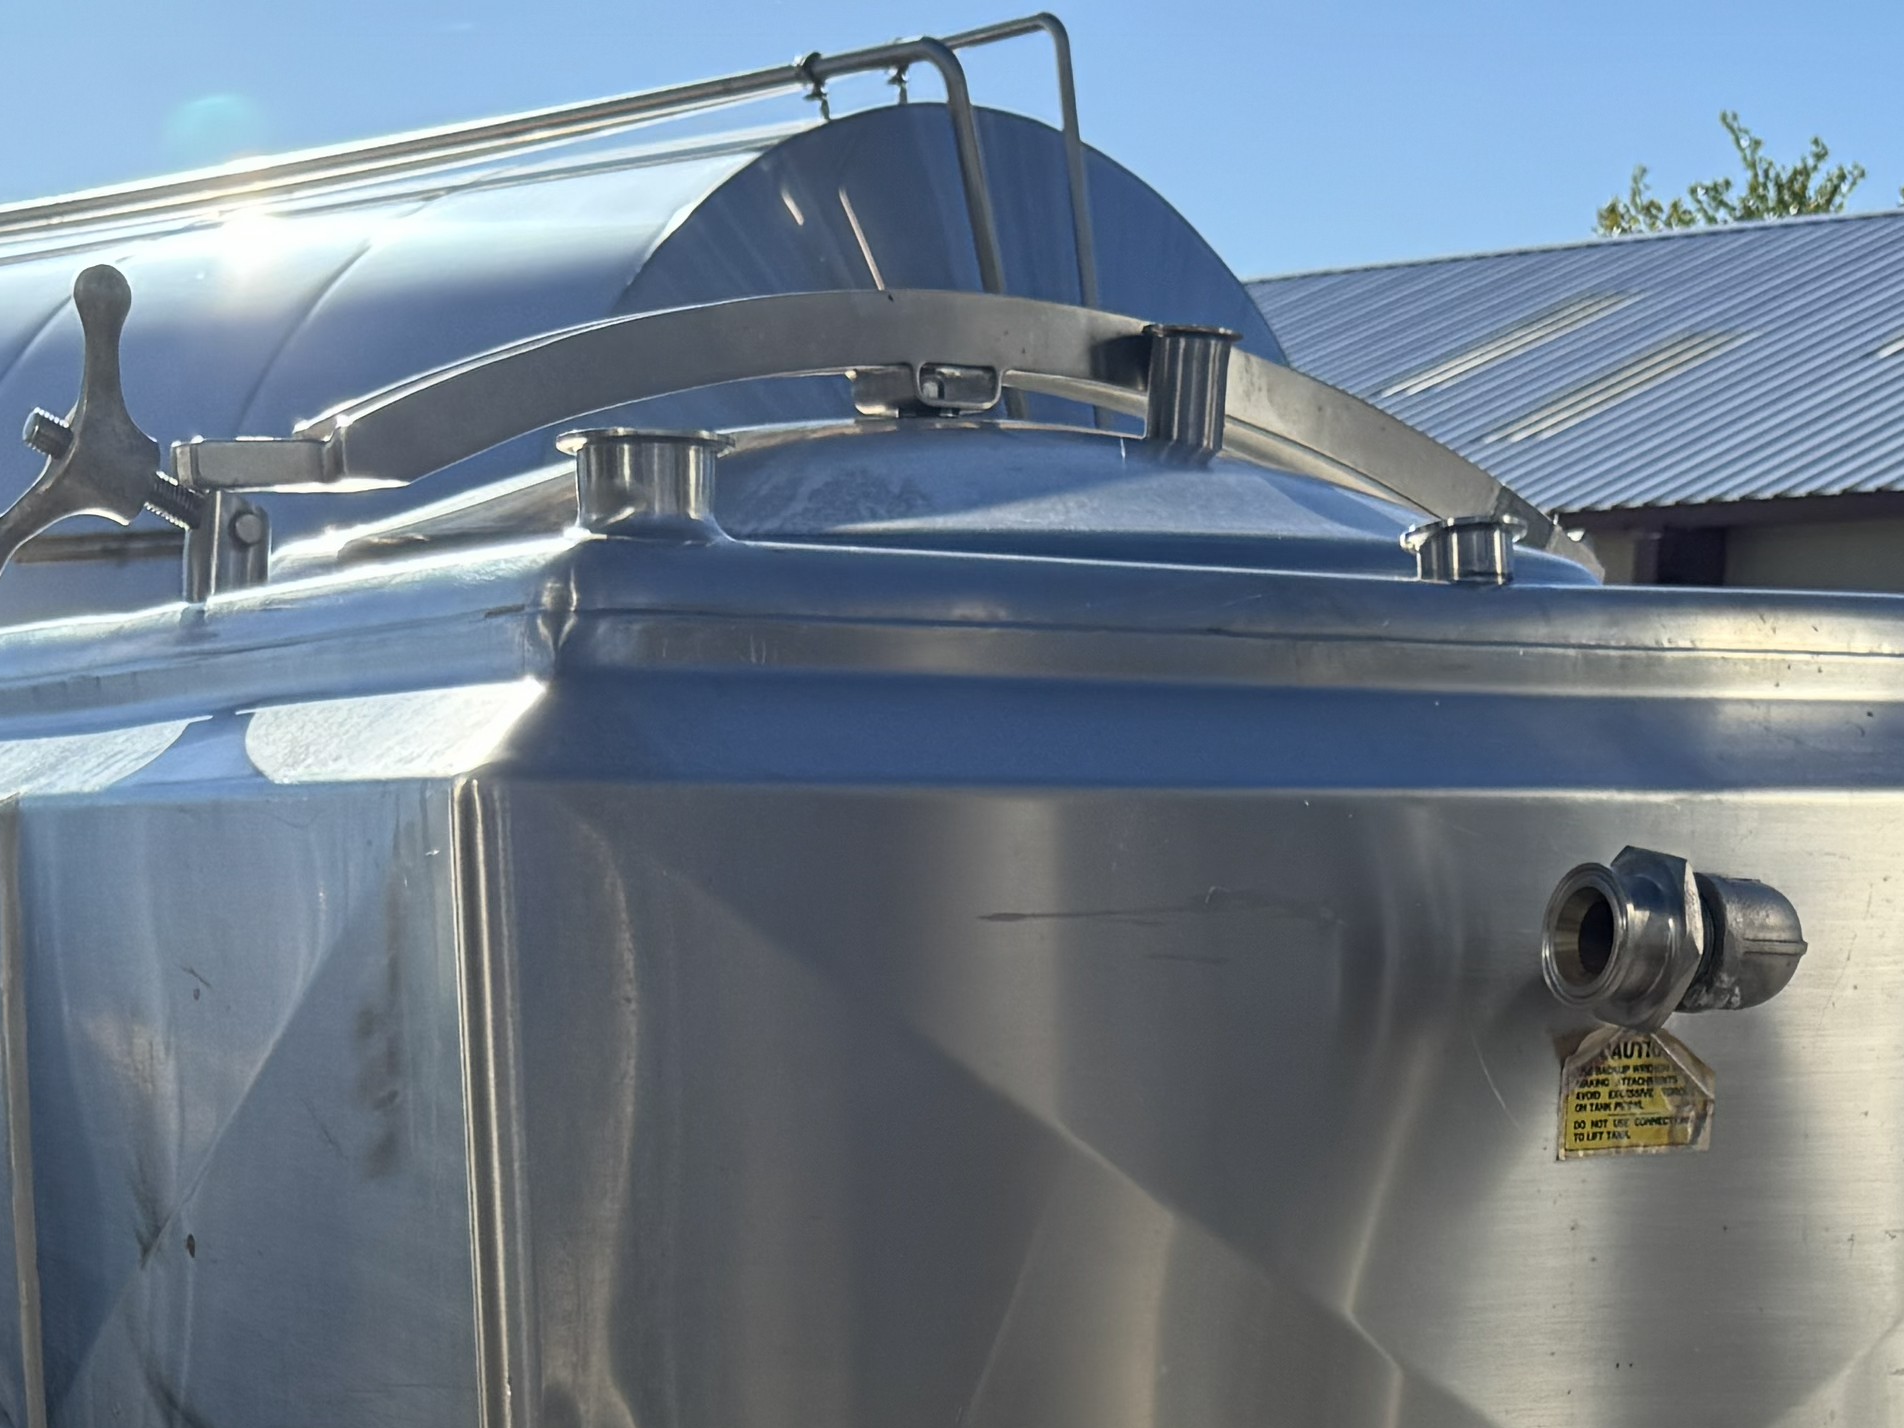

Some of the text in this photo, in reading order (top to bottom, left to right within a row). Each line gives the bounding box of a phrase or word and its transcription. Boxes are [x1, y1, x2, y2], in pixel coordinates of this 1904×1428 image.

[1573, 1120, 1586, 1130] DO
[1591, 1119, 1608, 1129] NOT
[1573, 1133, 1585, 1143] TO
[1586, 1131, 1604, 1142] LIFT
